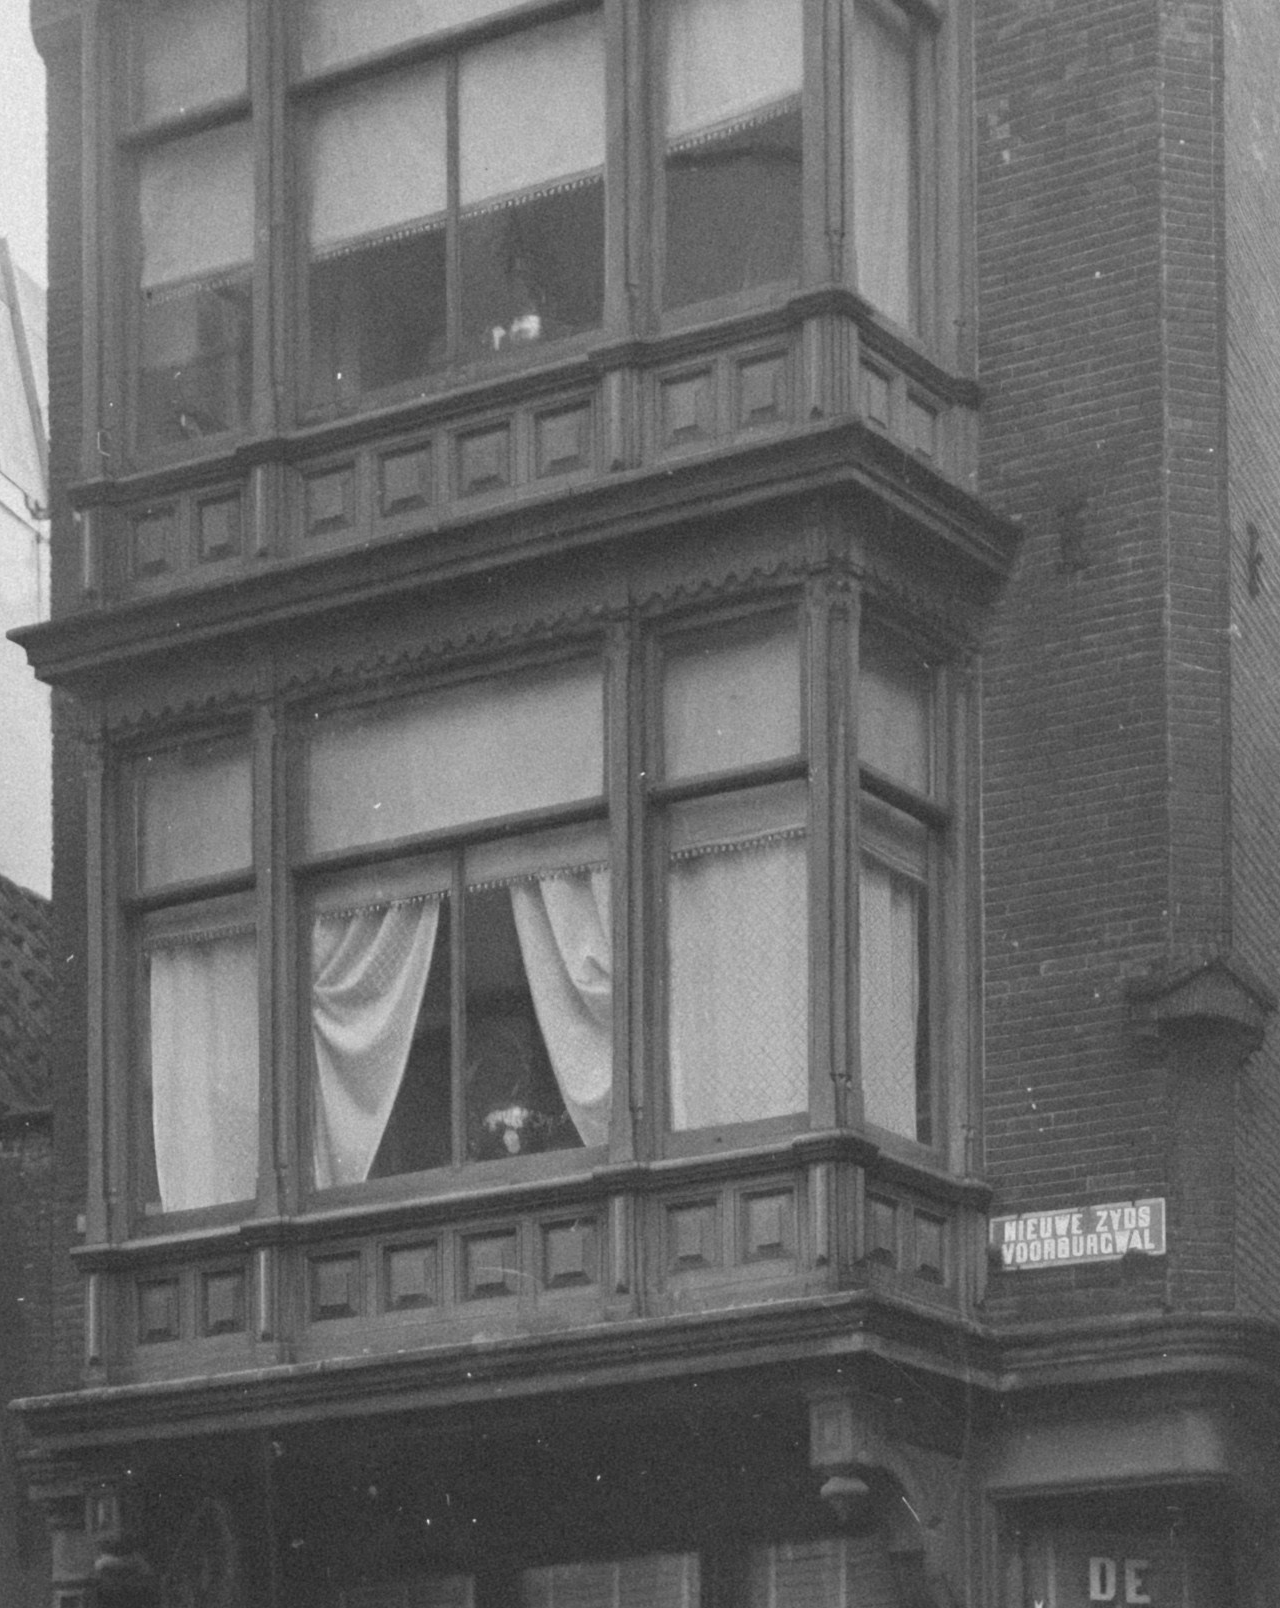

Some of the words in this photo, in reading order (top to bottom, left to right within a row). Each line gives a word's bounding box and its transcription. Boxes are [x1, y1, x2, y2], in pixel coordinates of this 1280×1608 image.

[1004, 1213, 1083, 1242] NIEUWE
[1002, 1228, 1155, 1265] VOORBURGWAL
[1089, 1556, 1152, 1604] DE
